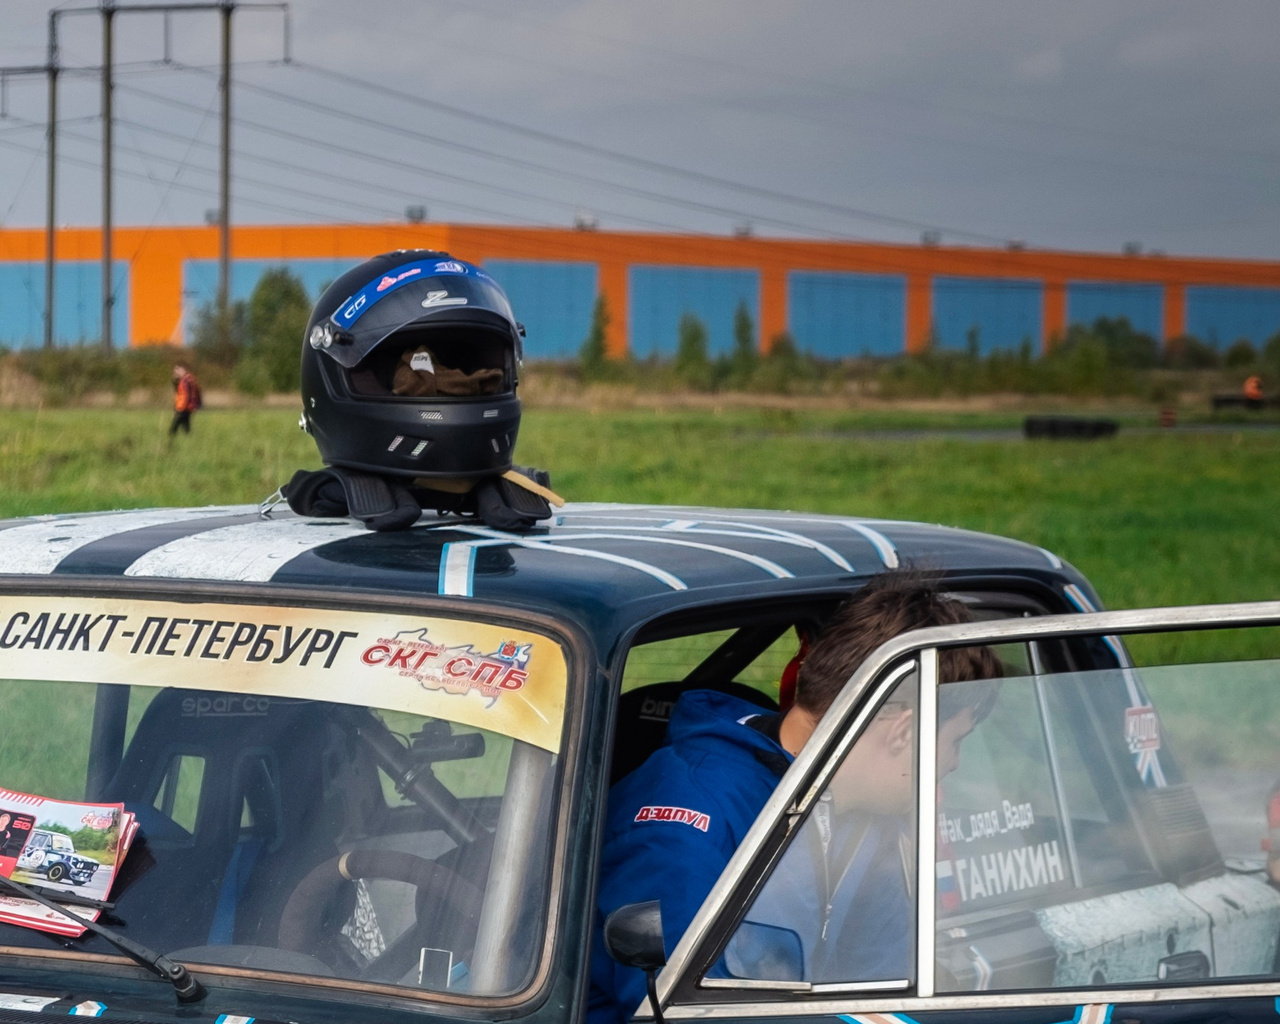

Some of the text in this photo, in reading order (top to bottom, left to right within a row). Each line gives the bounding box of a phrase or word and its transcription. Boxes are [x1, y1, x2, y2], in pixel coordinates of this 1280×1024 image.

[359, 644, 440, 671] СКГ
[442, 656, 532, 692] СПБ
[181, 697, 270, 717] sparco
[634, 805, 711, 832] ДЭДПУЛ
[955, 840, 1064, 902] ГАНИХИН
